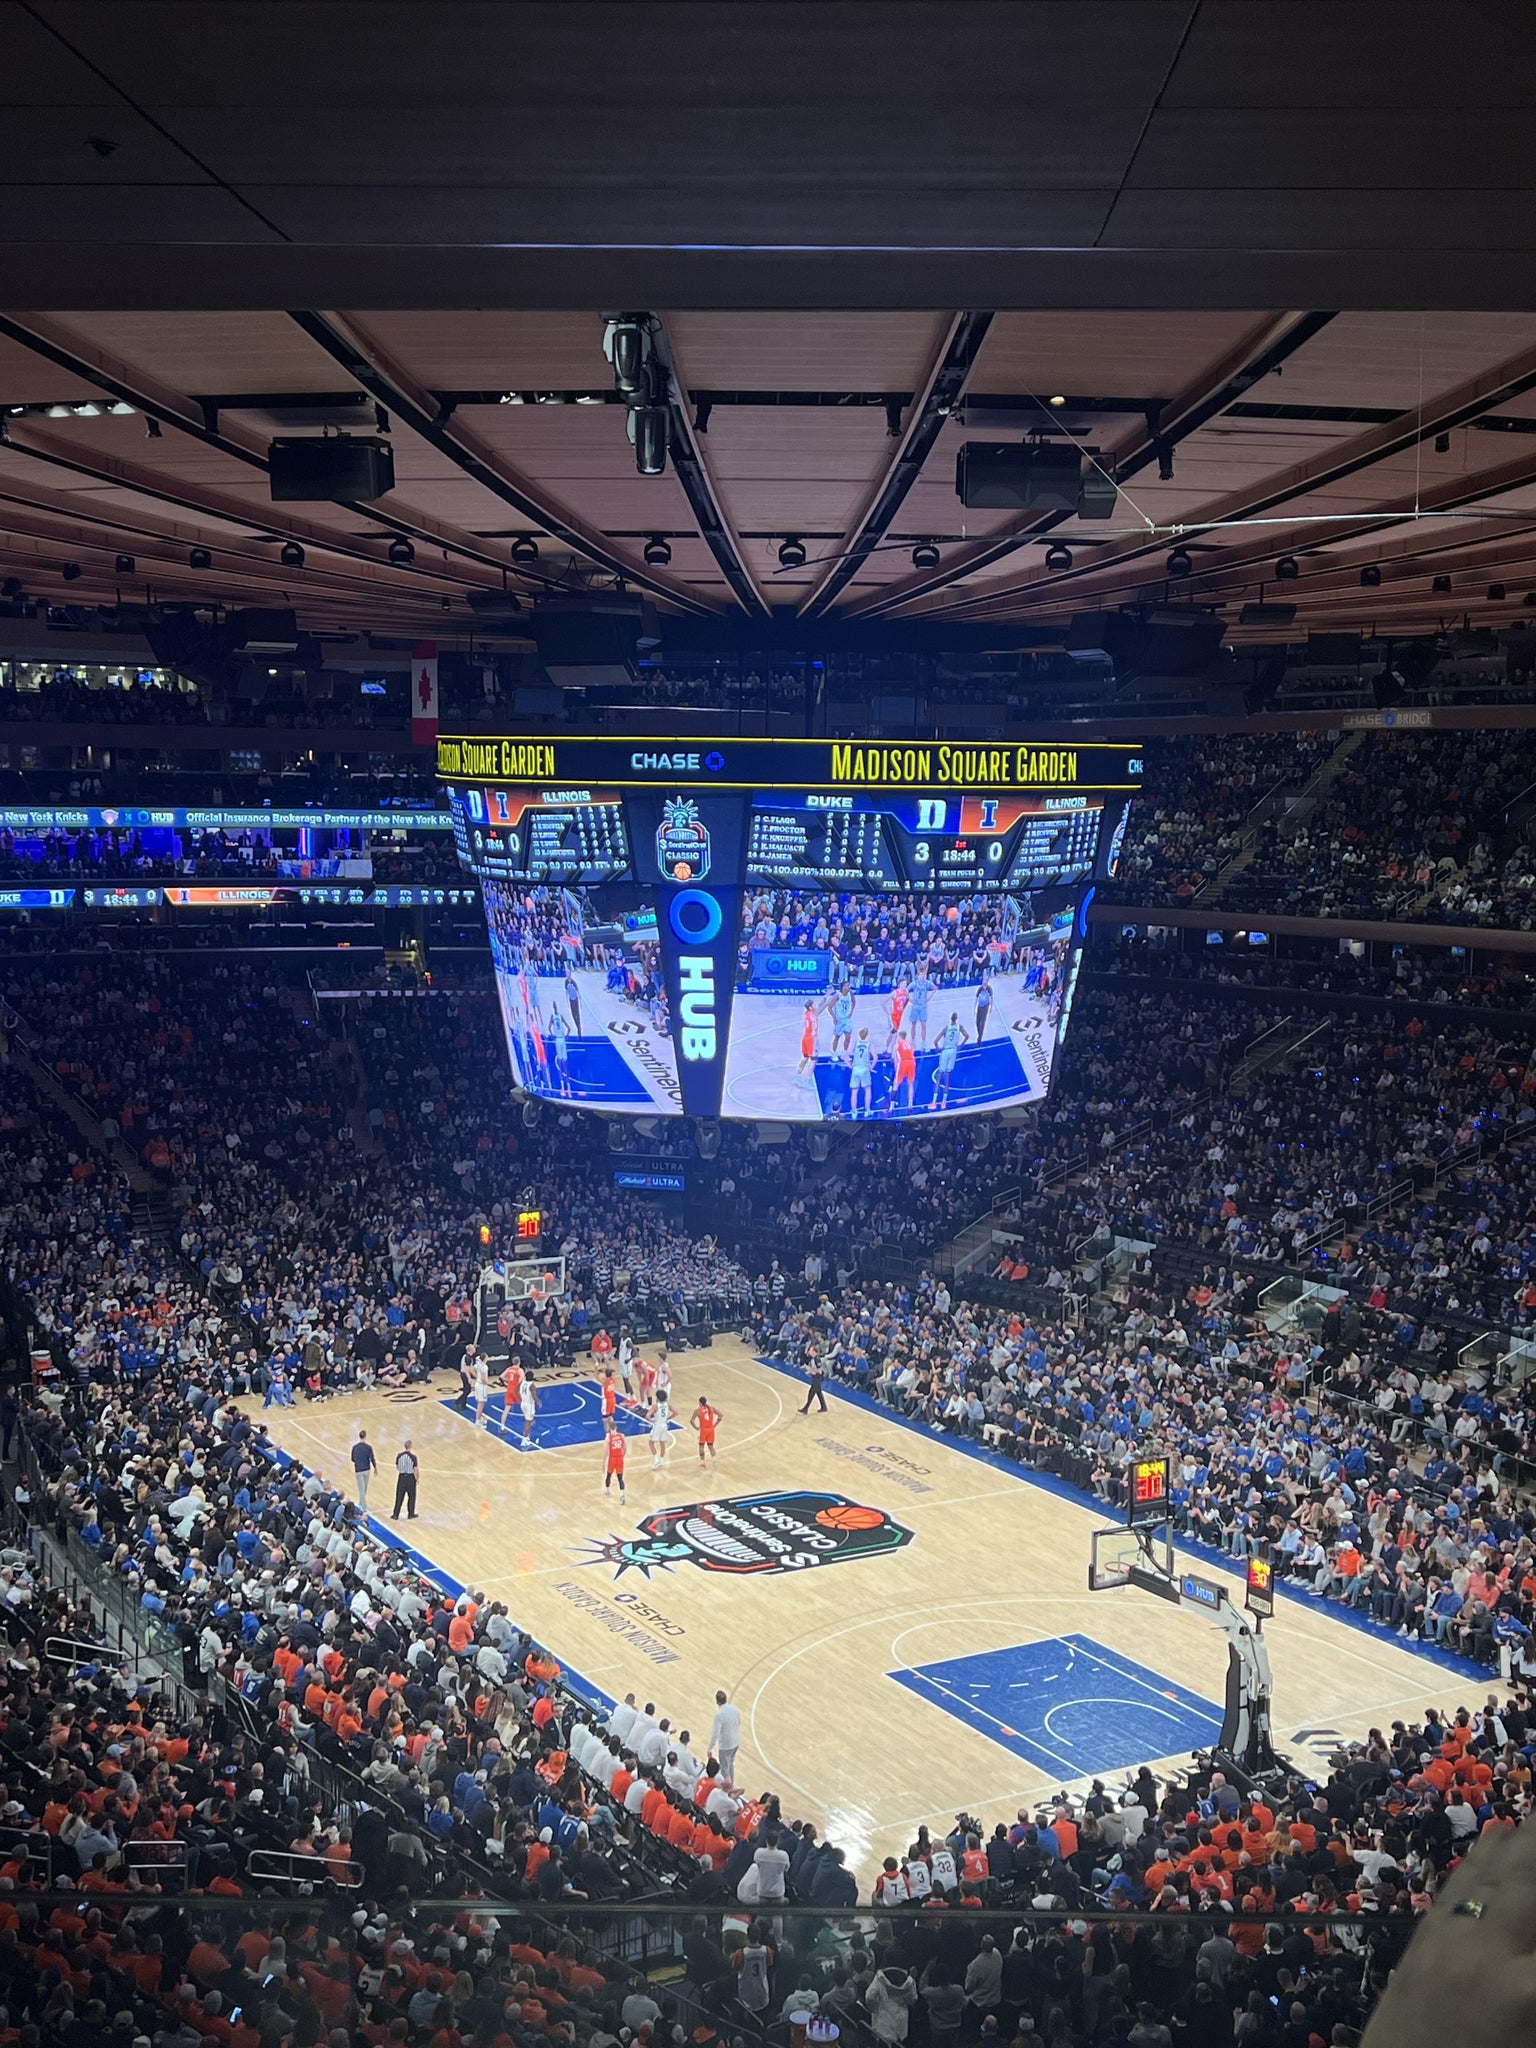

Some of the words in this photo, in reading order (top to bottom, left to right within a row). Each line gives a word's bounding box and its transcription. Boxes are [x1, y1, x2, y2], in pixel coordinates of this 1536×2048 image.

[1397, 712, 1432, 724] BRIDGE
[462, 741, 499, 775] SQUARE
[502, 741, 555, 776] GARDEN
[631, 753, 700, 770] CHASE
[832, 744, 931, 782] MADISON
[938, 746, 1010, 784] SQUARE
[1016, 746, 1077, 783] GARDEN
[542, 791, 591, 803] ILLINOIS
[807, 796, 853, 808] DUKE
[1046, 797, 1087, 809] ILLINOIS
[5, 812, 28, 820] New
[30, 812, 53, 822] York
[55, 812, 88, 820] Knicks
[151, 812, 174, 821] HUB
[186, 812, 222, 822] Official
[224, 812, 270, 822] Insurance
[272, 813, 322, 824] Brokerage
[324, 814, 360, 823] Partner
[361, 814, 372, 824] of
[374, 814, 390, 824] the
[392, 815, 413, 824] New
[415, 815, 437, 824] York
[439, 815, 454, 824] Kn
[916, 799, 947, 830] D
[980, 800, 999, 829] I
[509, 833, 520, 853] 0
[666, 852, 700, 860] CLASSIC
[915, 842, 930, 861] 3
[943, 850, 976, 861] 18:44
[989, 842, 1002, 861] 0
[748, 864, 772, 873] 3PT%
[774, 866, 799, 875] 100.0
[820, 868, 844, 876] 100.0
[869, 870, 883, 878] 0.0
[930, 868, 935, 877] 1
[978, 868, 984, 877] 0
[905, 880, 910, 889] 1
[928, 881, 934, 889] 3
[1002, 879, 1008, 887] 3
[103, 893, 138, 905] 18:44
[146, 889, 156, 900] 0
[219, 890, 270, 900] ILLINOIS
[787, 960, 817, 972] HUB
[679, 956, 717, 1062] HUB
[651, 1161, 684, 1171] ULTRA
[652, 1177, 680, 1187] ULTRA
[660, 1408, 667, 1418] 5
[611, 1440, 622, 1449] 32
[879, 1451, 932, 1475] CHASE
[1136, 1474, 1163, 1501] 30
[703, 1503, 792, 1553] SentinelOne
[751, 1505, 838, 1549] CLASSIC
[1255, 1573, 1267, 1588] 30
[552, 1581, 601, 1608] GARDEN
[1195, 1586, 1215, 1602] HUB
[586, 1605, 636, 1633] SQUARE
[627, 1602, 686, 1636] CHASE
[621, 1630, 681, 1664] MADISON
[564, 1823, 572, 1836] 1
[938, 1860, 953, 1874] 32
[975, 1860, 983, 1873] 4
[916, 1871, 925, 1884] 3
[1218, 1875, 1228, 1891] 1
[891, 1883, 898, 1896] 7
[752, 1963, 760, 1977] 3
